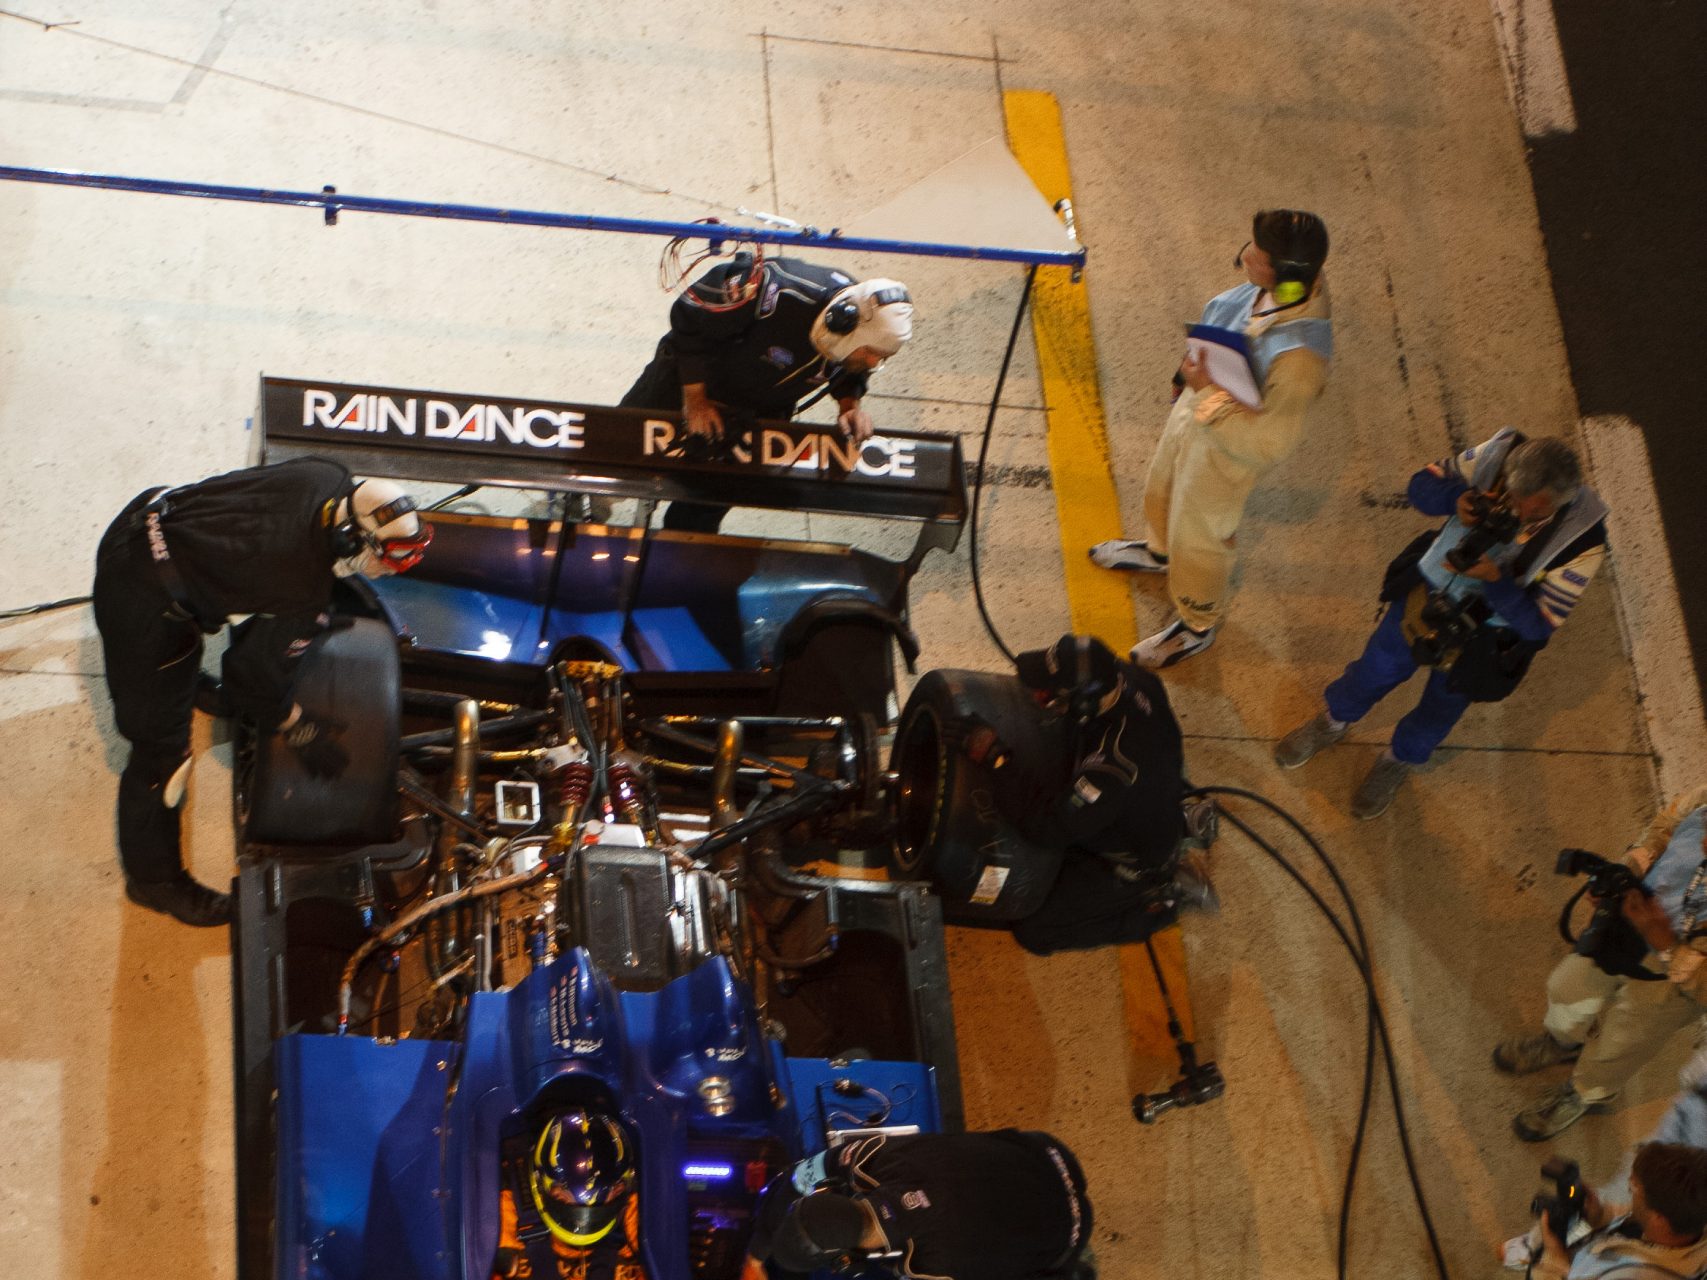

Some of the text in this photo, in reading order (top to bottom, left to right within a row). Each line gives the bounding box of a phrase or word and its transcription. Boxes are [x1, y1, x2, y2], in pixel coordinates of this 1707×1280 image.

[302, 389, 417, 437] RAIN
[425, 401, 586, 449] DANCE
[761, 429, 917, 478] DANCE
